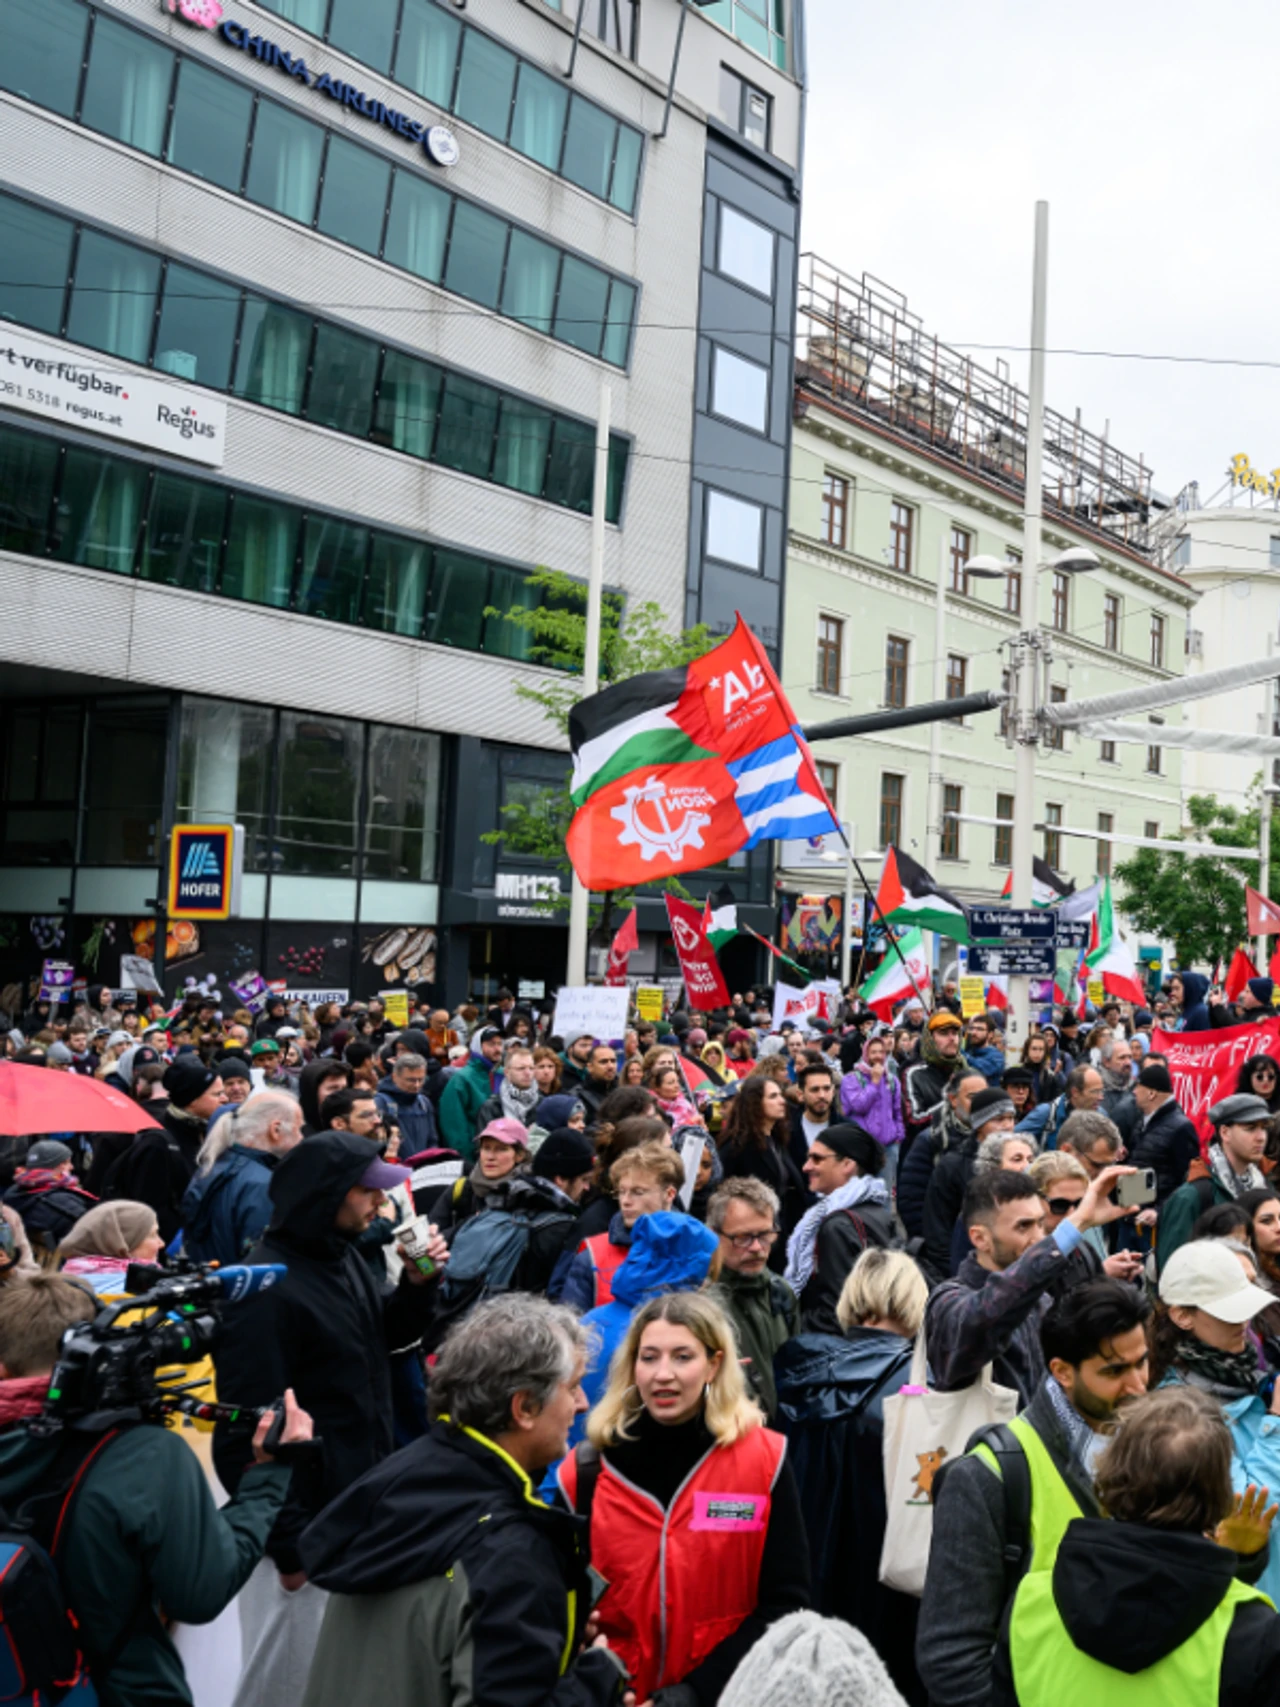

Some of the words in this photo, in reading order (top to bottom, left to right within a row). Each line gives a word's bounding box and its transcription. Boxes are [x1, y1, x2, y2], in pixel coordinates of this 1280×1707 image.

[219, 19, 310, 84] CHINA
[314, 71, 424, 146] AIRLINES
[20, 354, 129, 400] verfügbar.
[66, 401, 123, 427] regus.at
[157, 403, 216, 439] Regus
[181, 882, 221, 898] HOFER
